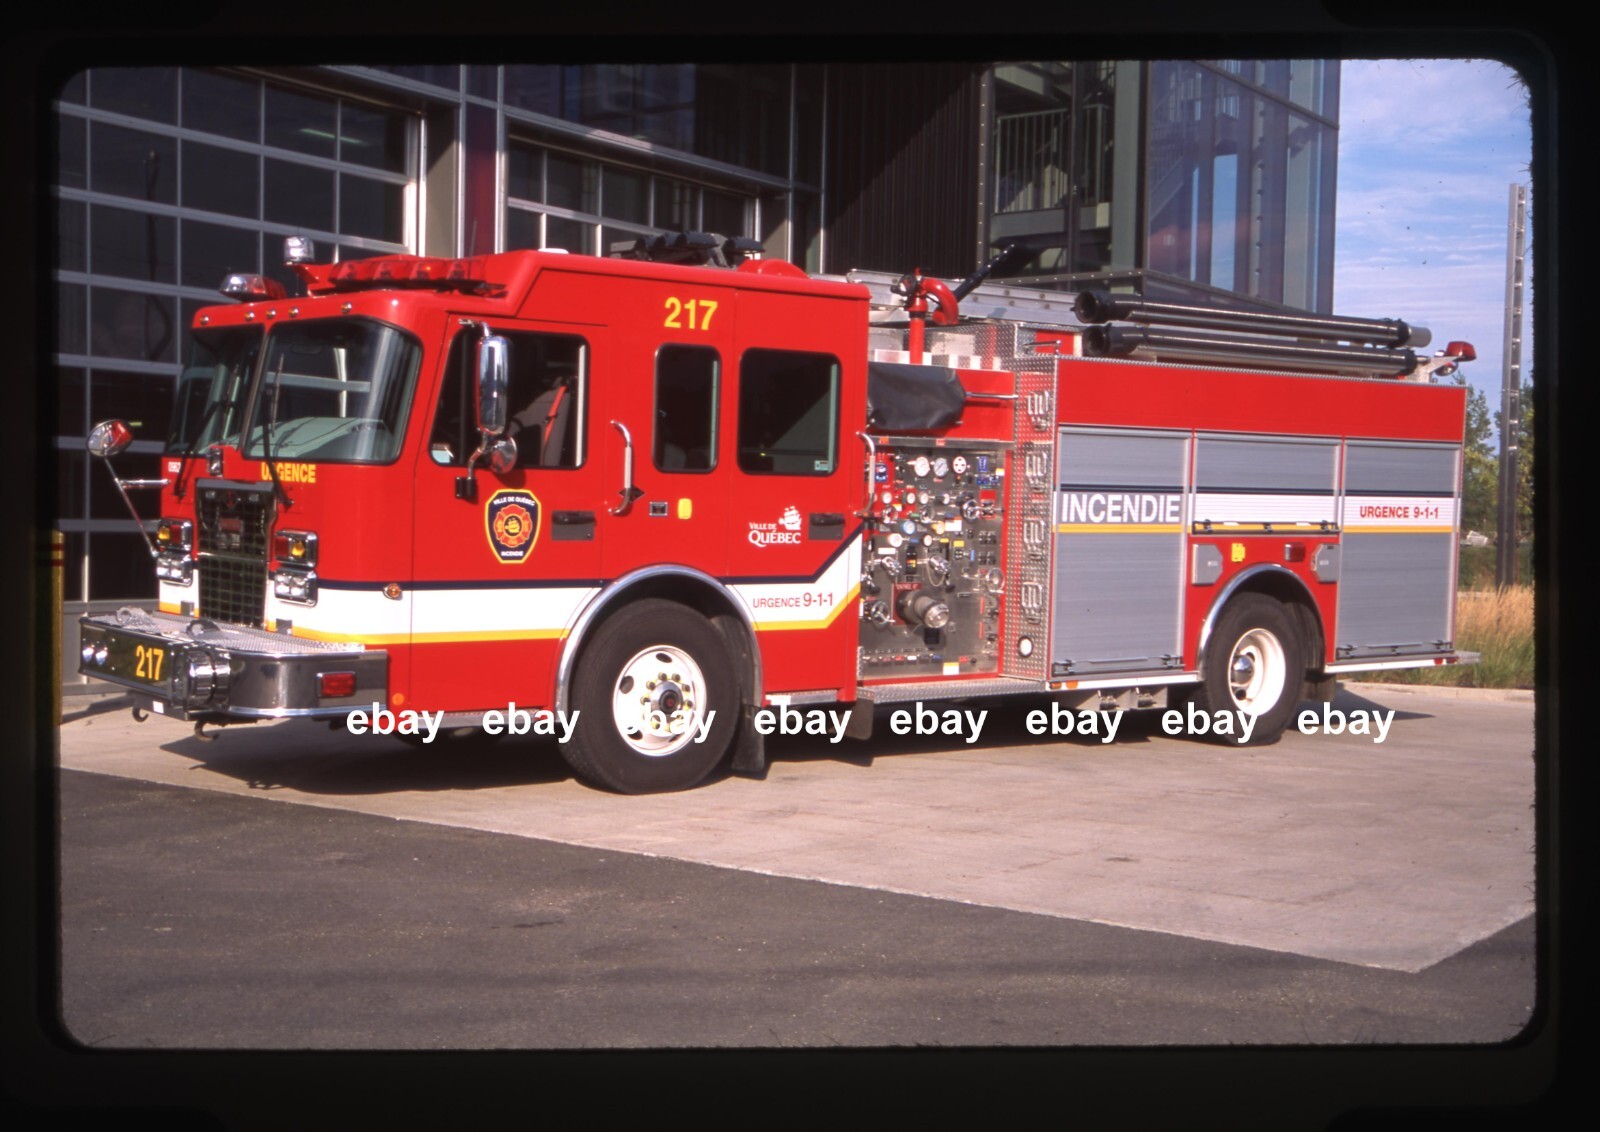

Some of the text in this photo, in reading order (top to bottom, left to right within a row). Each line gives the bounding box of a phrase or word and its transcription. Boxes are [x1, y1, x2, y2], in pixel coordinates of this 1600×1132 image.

[664, 296, 718, 331] 217
[1062, 492, 1181, 523] INCENDIE
[1359, 505, 1440, 519] URGENCE 9-1-1
[748, 529, 802, 547] QUÉBEC
[753, 592, 834, 608] URGENCE 9-1-1
[135, 645, 164, 680] 217
